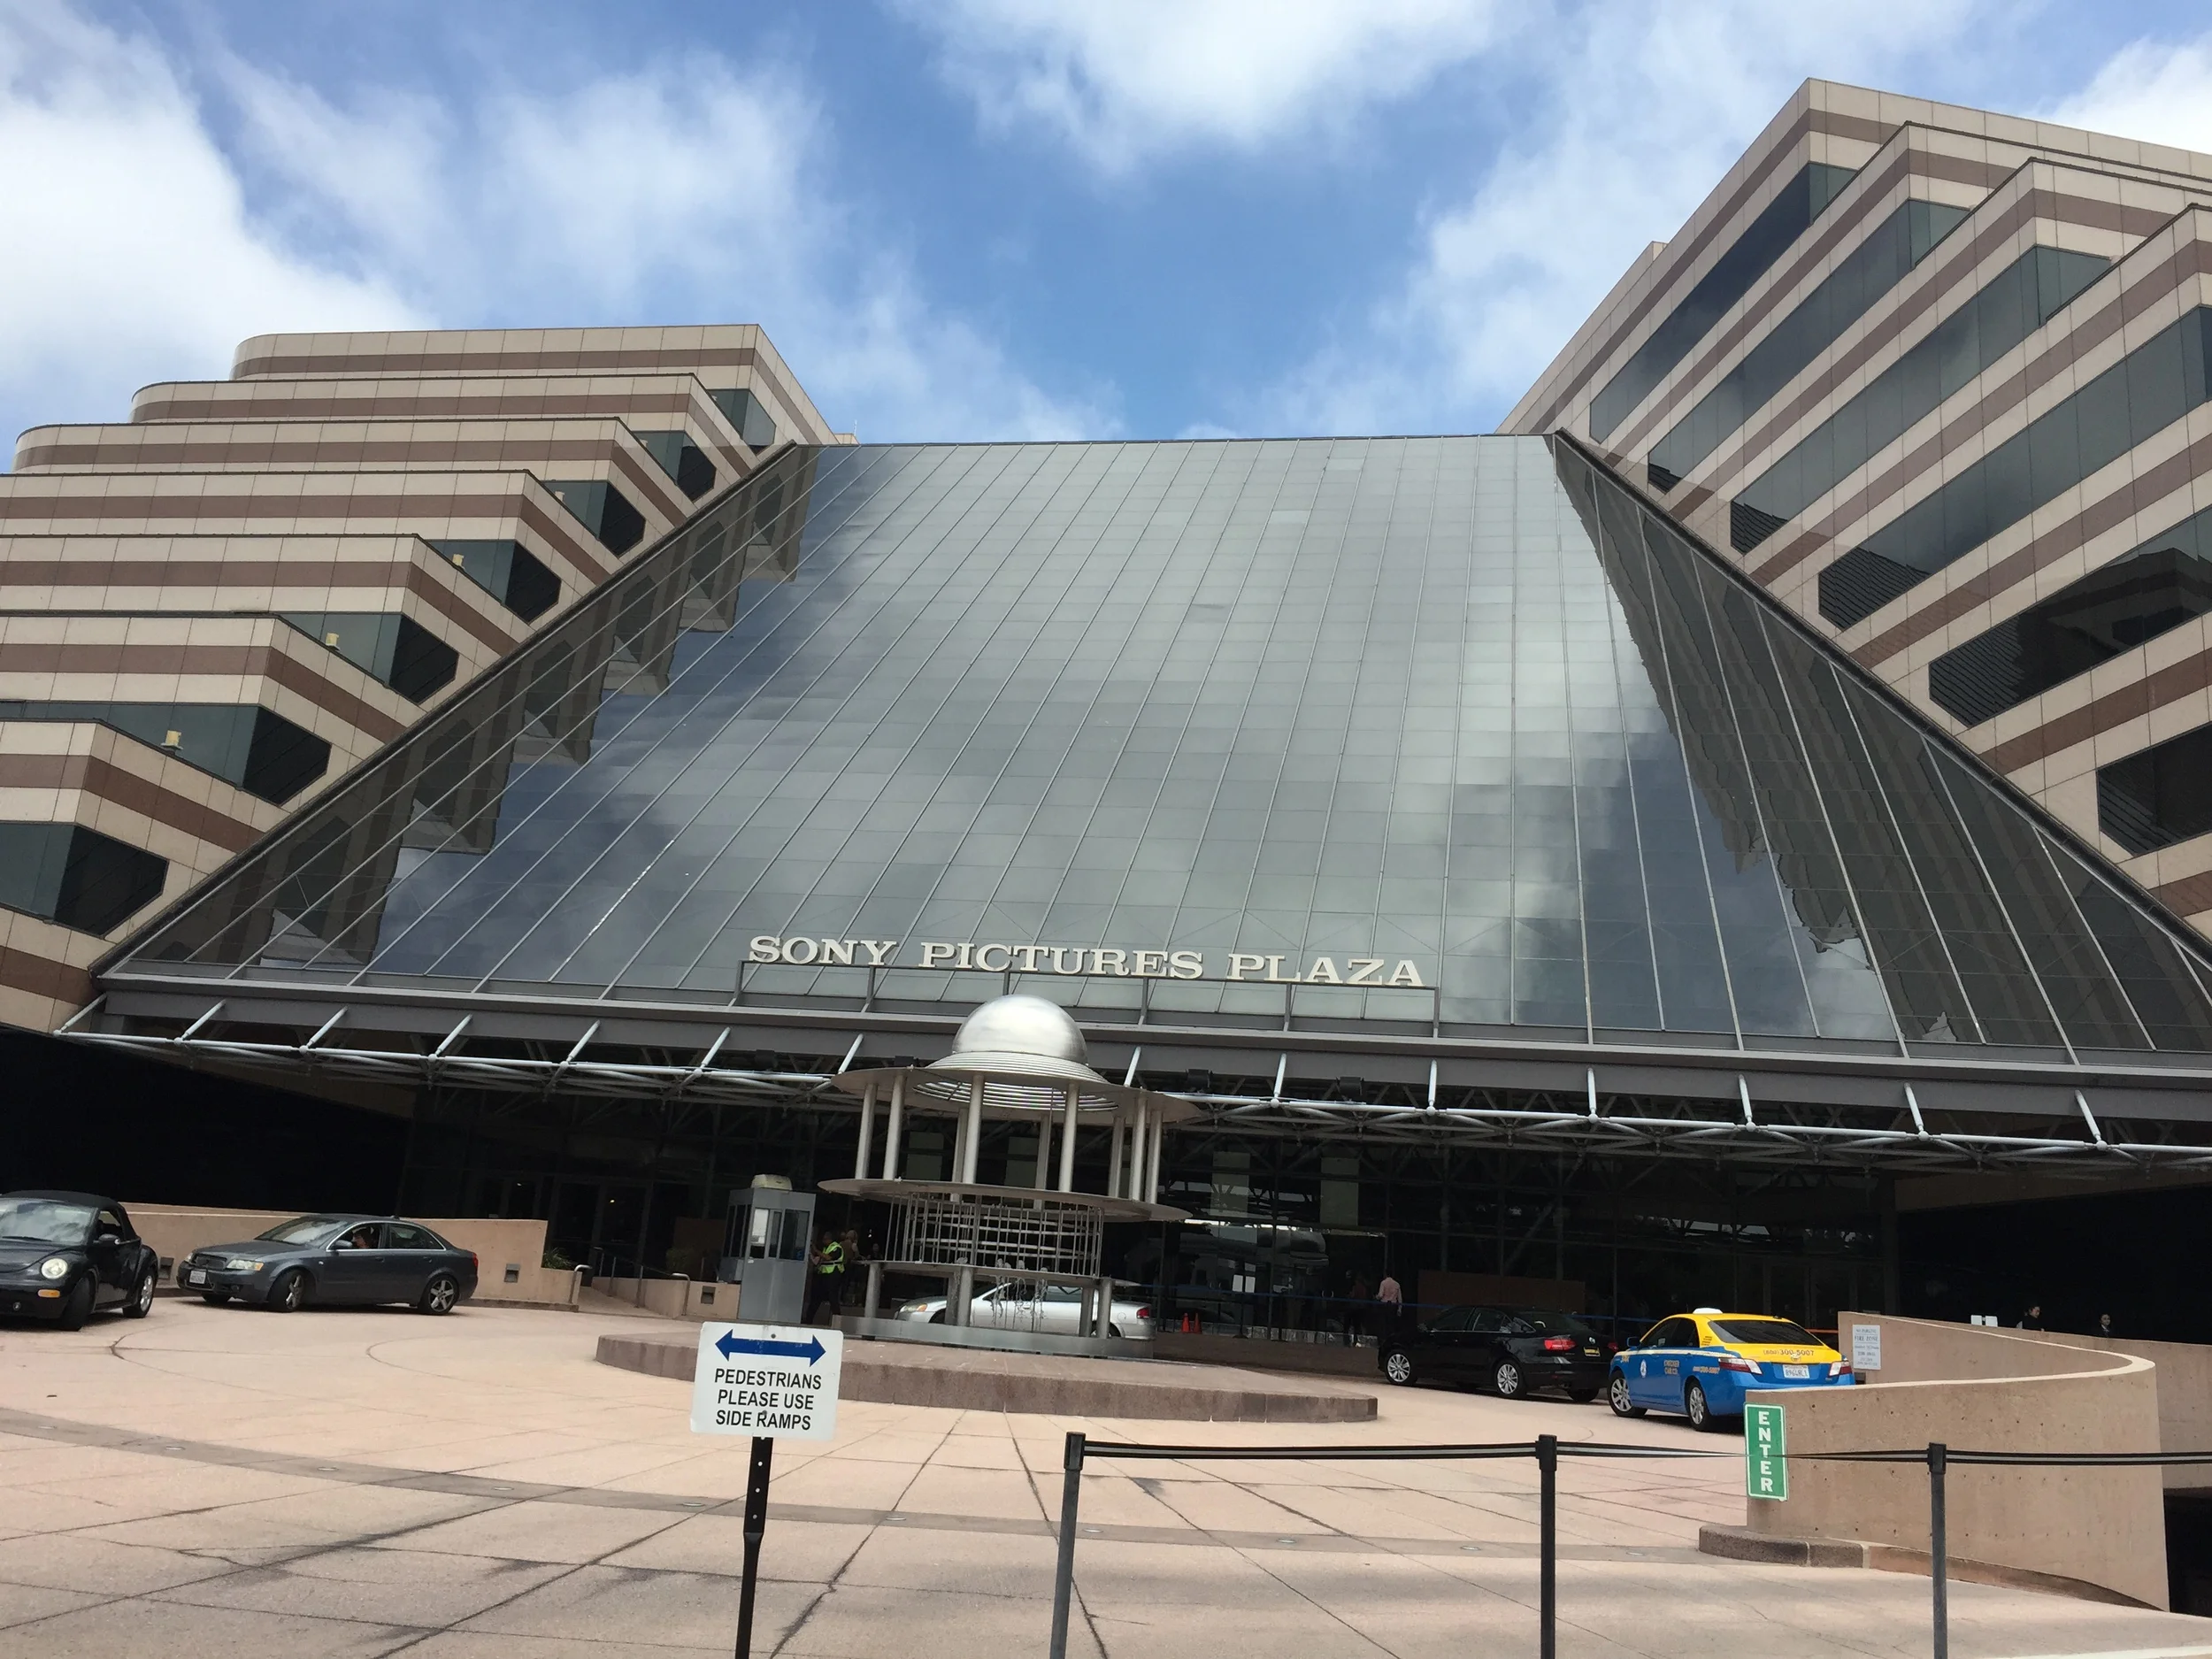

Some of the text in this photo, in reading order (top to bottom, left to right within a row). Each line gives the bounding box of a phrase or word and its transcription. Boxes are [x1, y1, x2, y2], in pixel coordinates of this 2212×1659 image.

[749, 936, 1425, 987] SONY PICTURES PLAZA
[714, 1368, 822, 1390] PEDESTRIANS
[718, 1389, 814, 1409] PLEASE USE
[716, 1409, 811, 1431] SIDE RAMPS
[1758, 1410, 1773, 1493] ENTER
